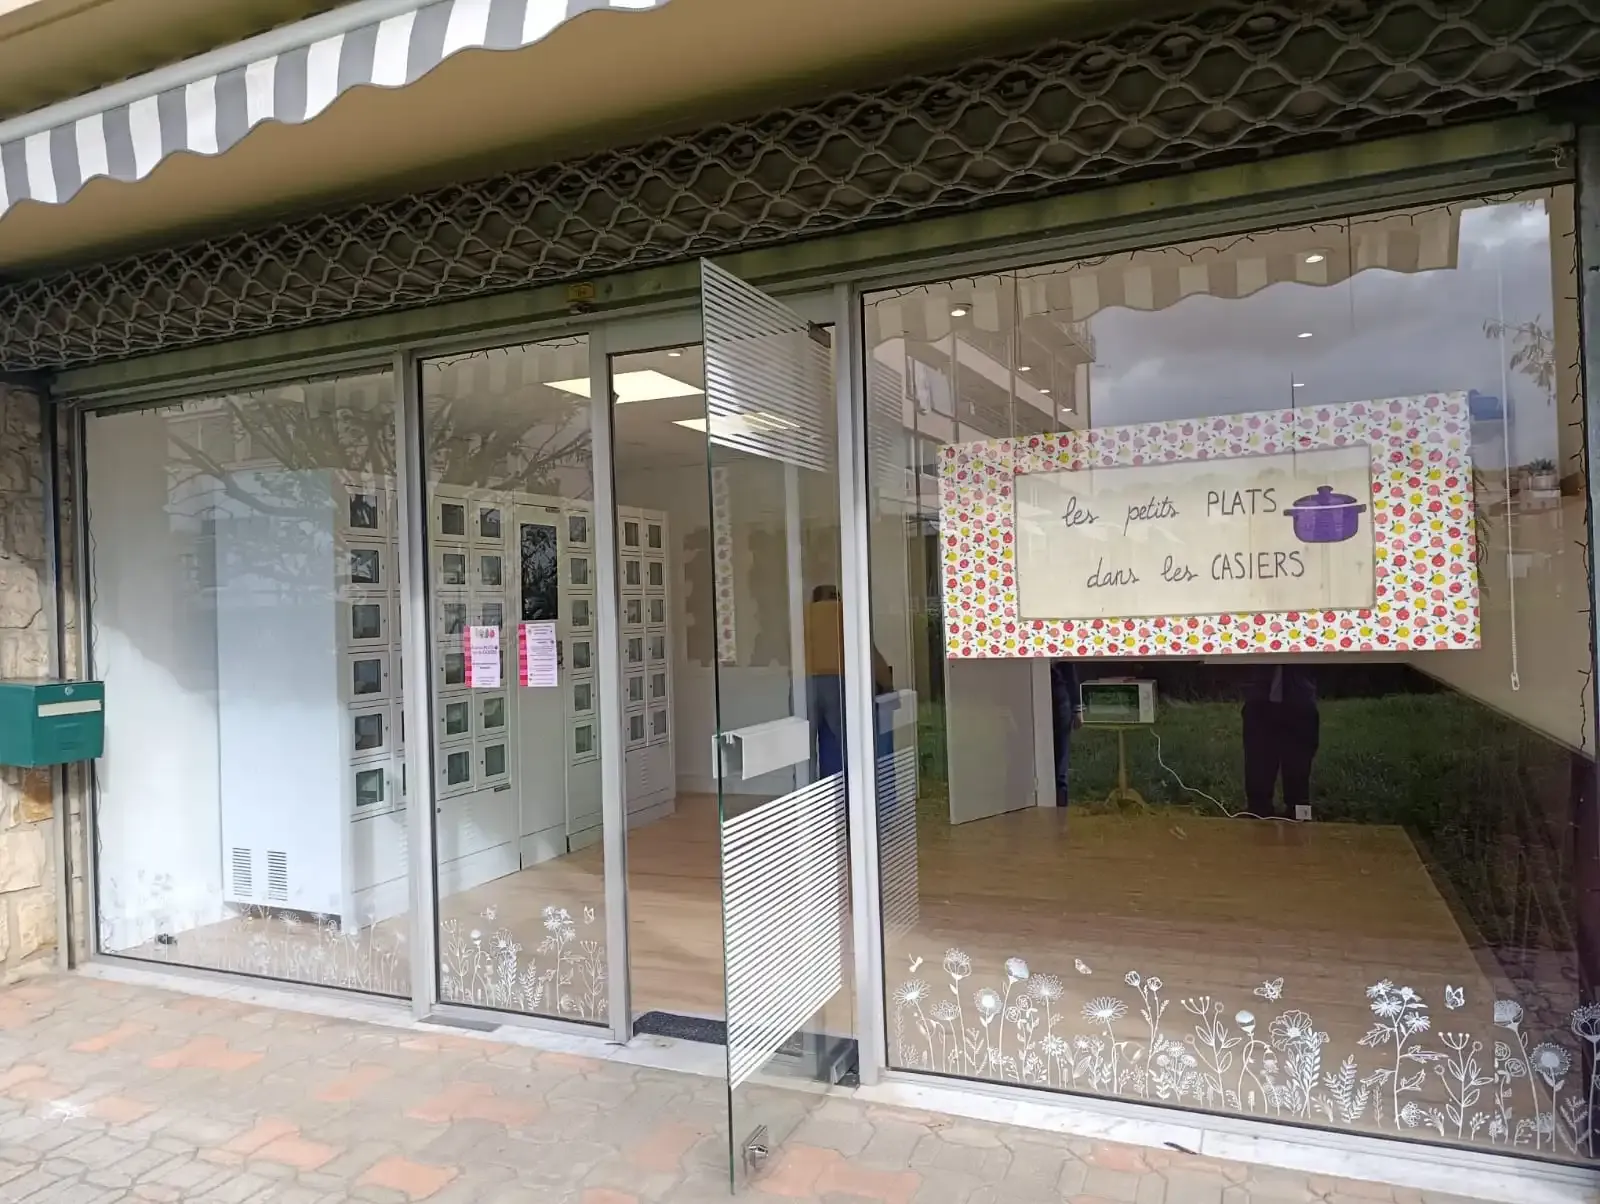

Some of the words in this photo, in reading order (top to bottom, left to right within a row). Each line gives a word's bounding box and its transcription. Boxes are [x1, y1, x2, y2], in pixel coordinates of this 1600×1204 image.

[1062, 496, 1099, 527] les
[1123, 495, 1180, 536] petits
[1207, 487, 1277, 516] PLATS
[1086, 556, 1140, 589] dans
[1161, 555, 1199, 583] les
[1211, 550, 1305, 581] CASIERS
